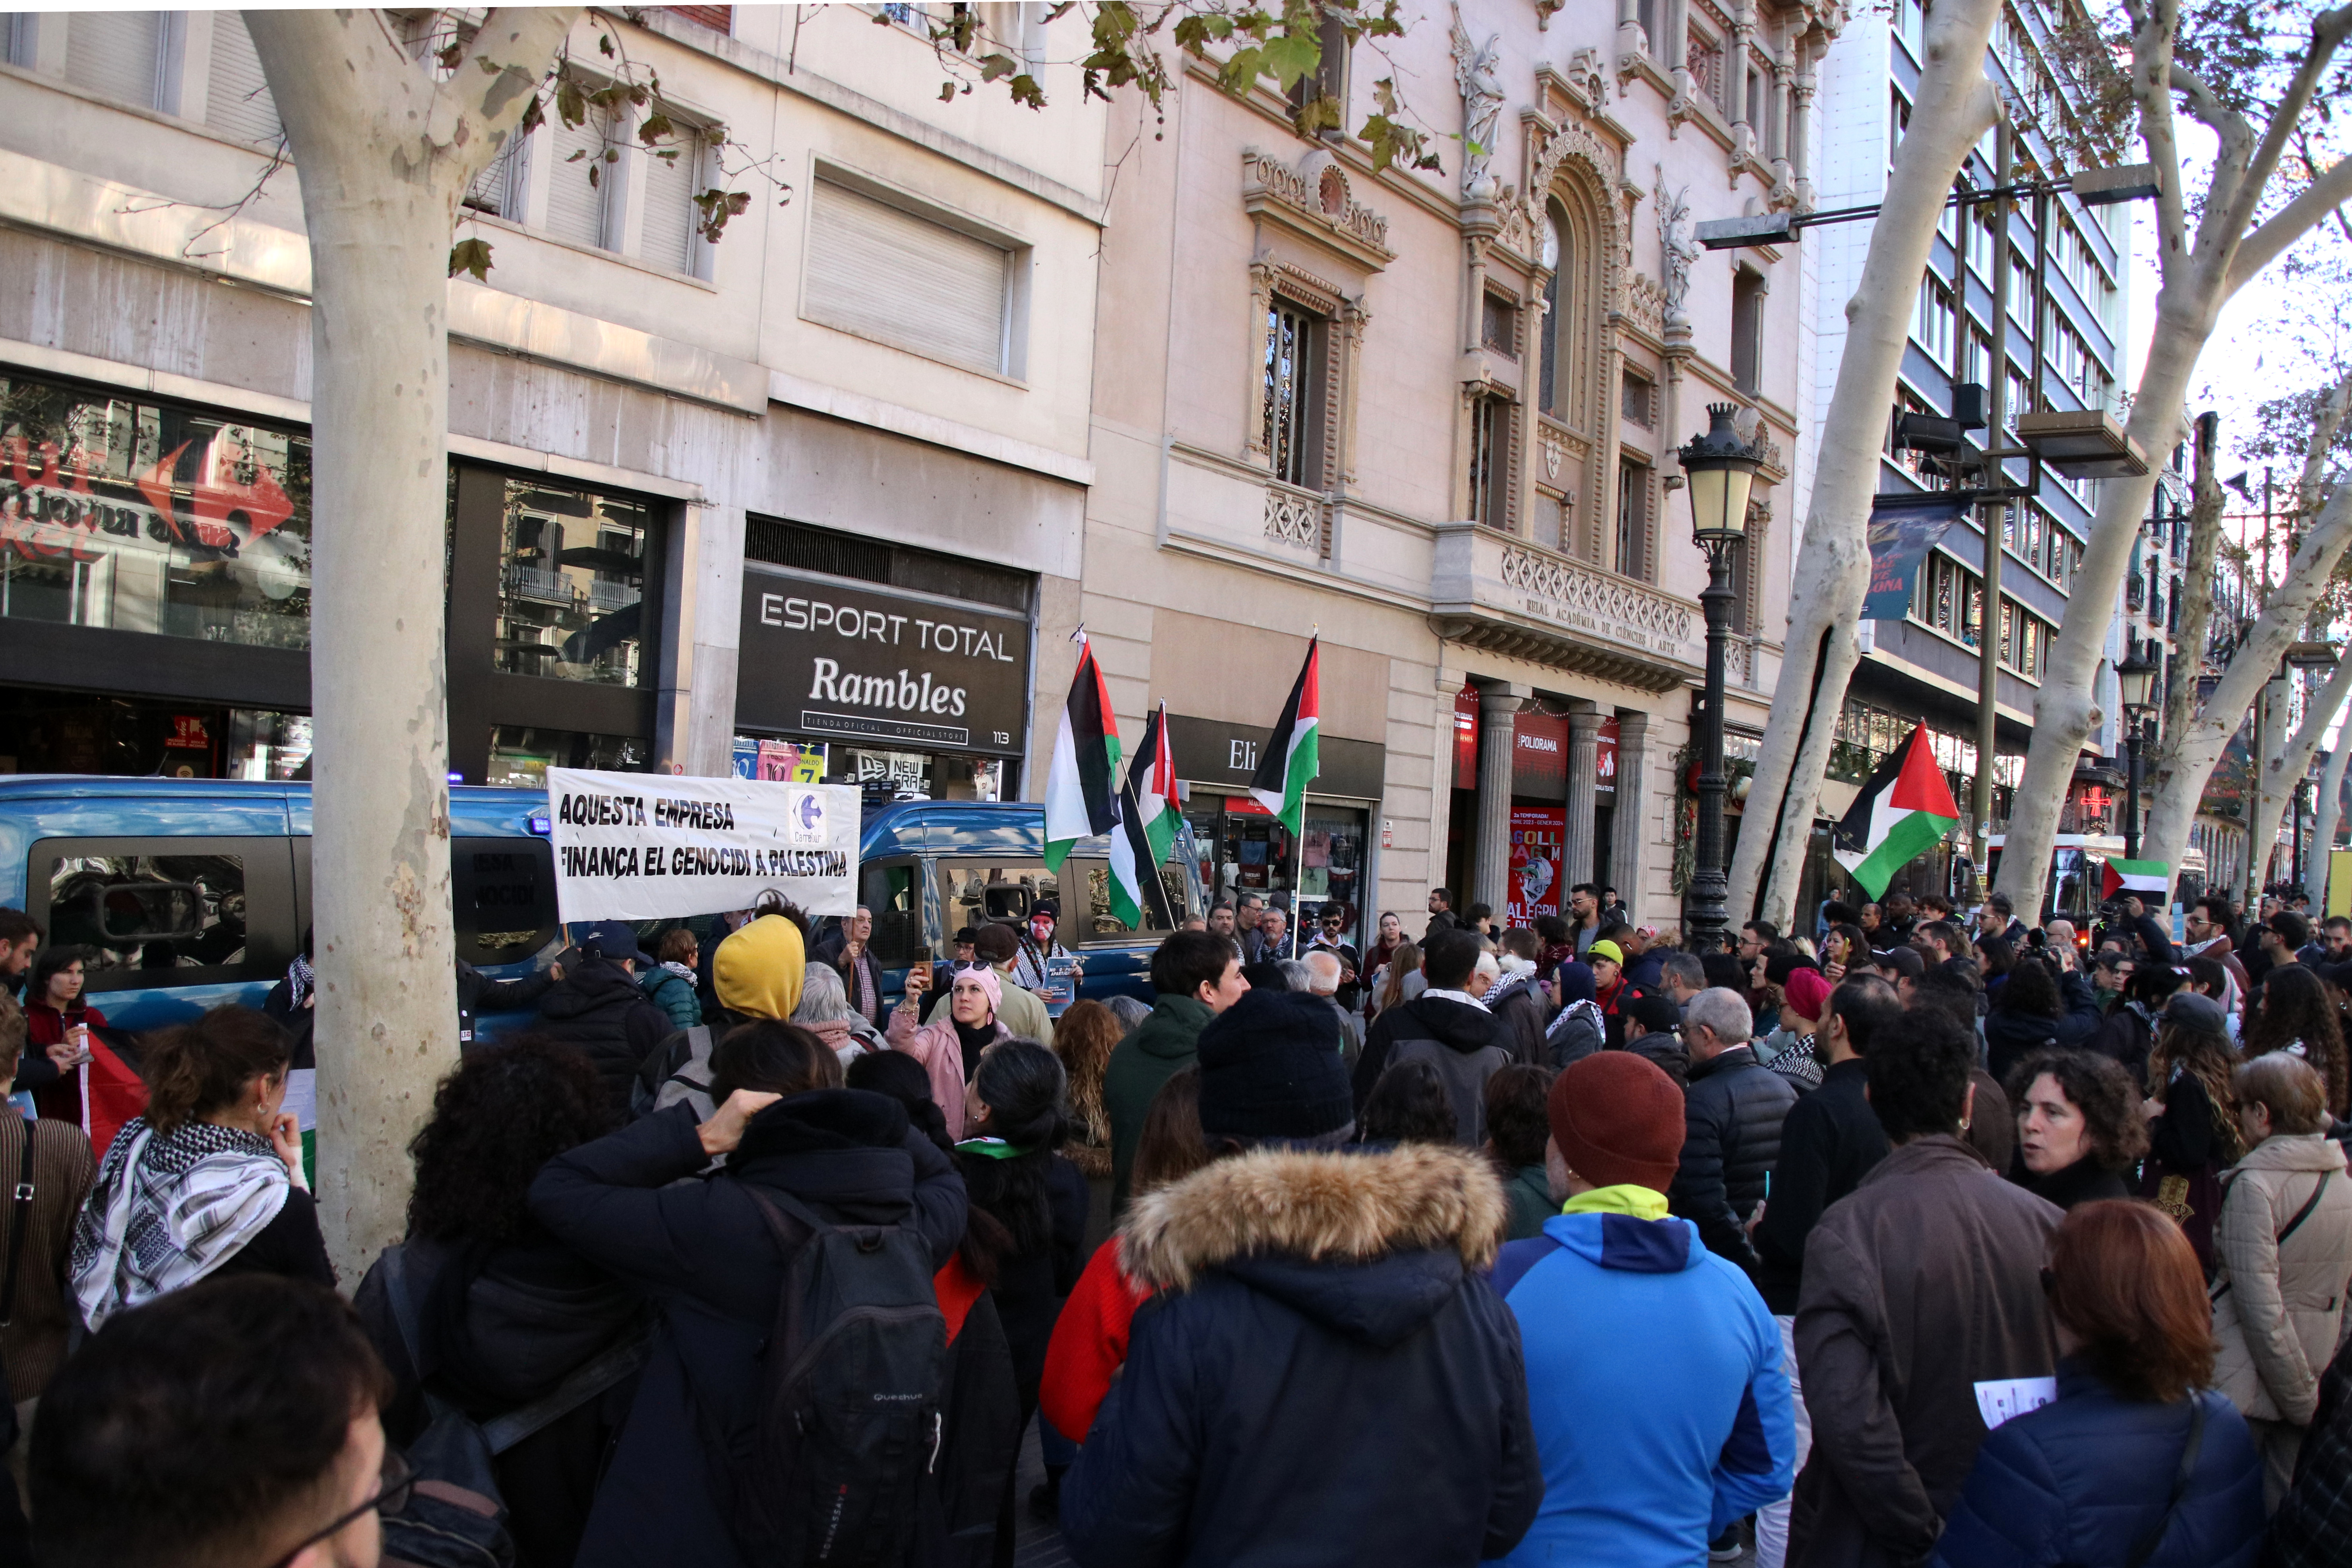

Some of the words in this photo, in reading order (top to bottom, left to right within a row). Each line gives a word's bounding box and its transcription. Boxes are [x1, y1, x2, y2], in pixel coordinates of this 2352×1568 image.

[761, 593, 908, 645] ESPORT
[915, 618, 1014, 662] TOTAL
[1527, 599, 1549, 616] REIAL
[1602, 621, 1610, 634] DE
[1651, 636, 1654, 647] I
[1658, 640, 1675, 655] ARTS
[808, 657, 967, 717] Rambles
[807, 717, 841, 727] TIENDA
[844, 722, 880, 732] OFICIAL
[896, 727, 936, 737] OFFICIAL
[938, 732, 963, 740] STORE
[994, 731, 1009, 744] 113
[1521, 735, 1557, 752] POLIORAMA
[767, 763, 785, 781] 10
[801, 769, 814, 783] 7
[895, 760, 918, 774] NEW
[560, 794, 647, 827] AQUESTA
[655, 798, 734, 830] EMPRESA
[644, 847, 666, 876] EL
[673, 847, 751, 876] GENOCIDI
[756, 849, 767, 876] A
[770, 849, 847, 877] PALESTINA
